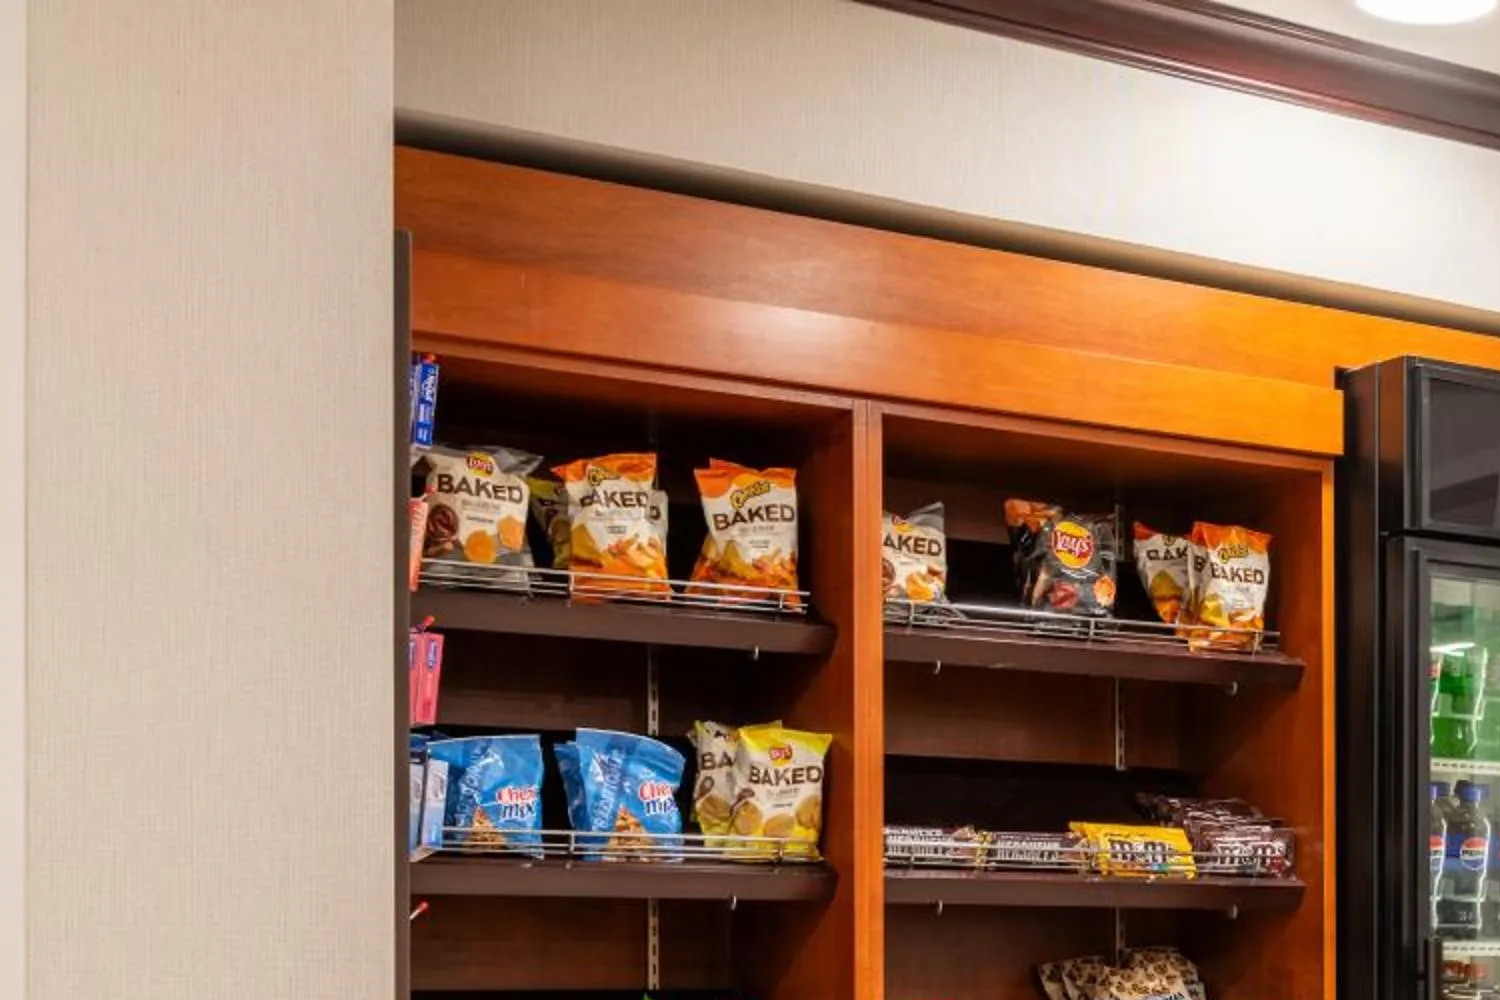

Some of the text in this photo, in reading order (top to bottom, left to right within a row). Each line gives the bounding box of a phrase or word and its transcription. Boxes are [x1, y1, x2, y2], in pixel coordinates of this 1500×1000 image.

[437, 473, 523, 504] BAKED
[712, 503, 795, 531] BAKED
[884, 534, 943, 557] AKED
[1054, 530, 1092, 557] Lay's
[749, 766, 822, 786] BAKED
